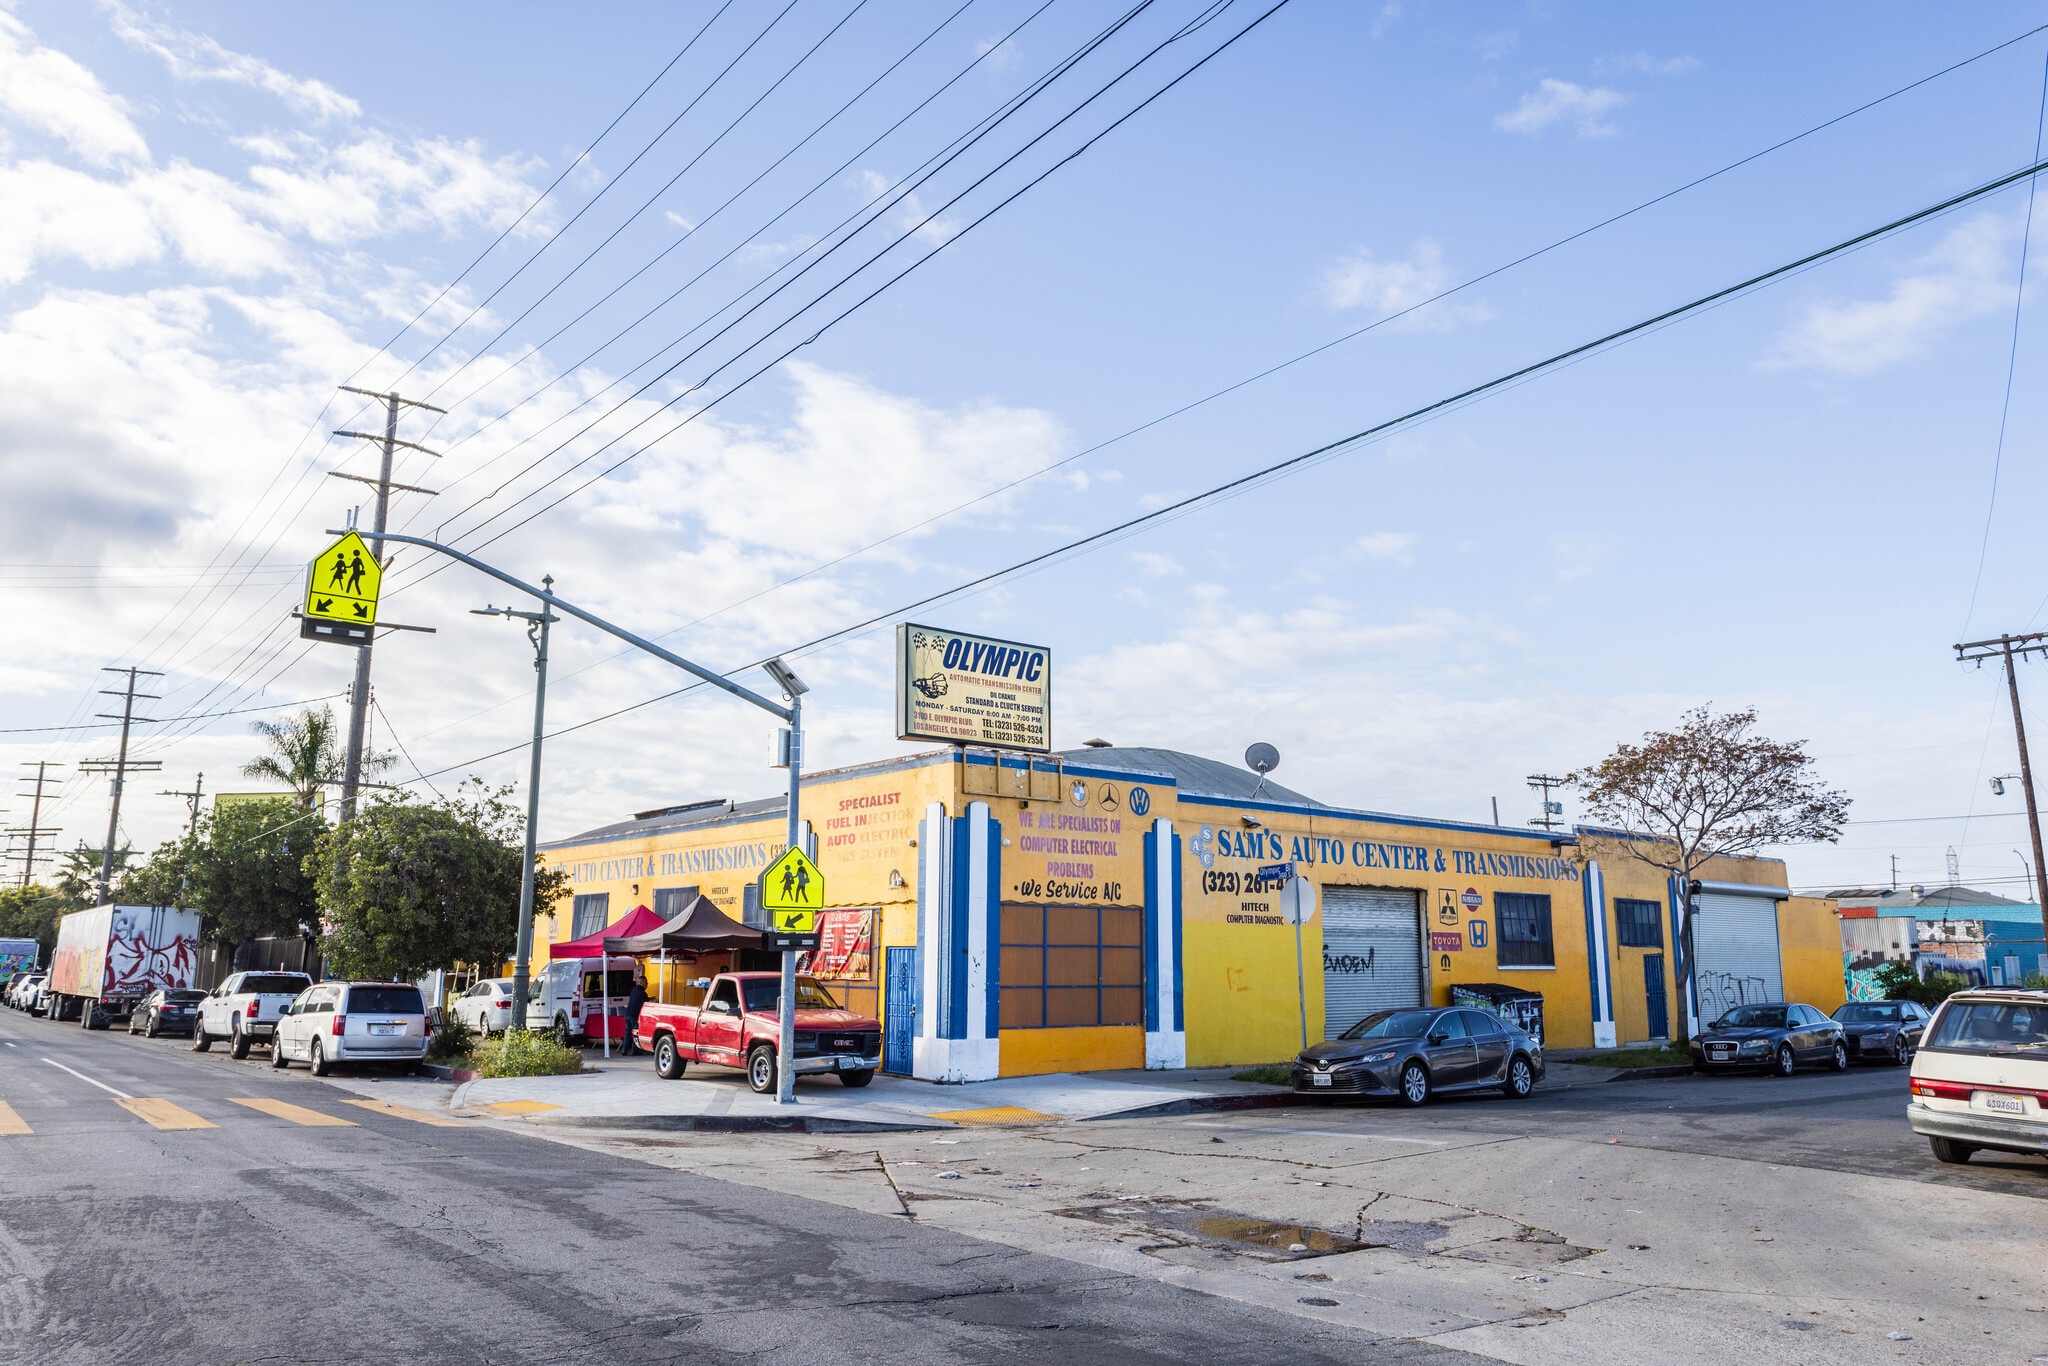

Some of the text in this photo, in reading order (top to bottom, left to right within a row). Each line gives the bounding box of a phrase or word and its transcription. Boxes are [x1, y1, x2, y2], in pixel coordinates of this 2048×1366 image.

[942, 638, 1044, 682] OLYMPIC
[949, 673, 1042, 694] AUTOMATIC TRANSMISSION CENTER
[998, 692, 1016, 701] CHANGE
[915, 700, 944, 710] MONDAY
[949, 705, 984, 716] SATURDAY
[986, 710, 1000, 718] 8:00
[1016, 714, 1030, 722] 7:00
[965, 696, 994, 708] STANDARD
[1000, 701, 1020, 711] CLUCTH
[1021, 704, 1043, 715] SERVICE
[913, 711, 928, 720] 3100
[934, 714, 958, 725] OLYMPIC
[959, 717, 974, 726] BLVD.
[982, 719, 1043, 734] TEL: (323) 526-4324
[913, 722, 977, 737] LOS ANGELES, CA 90023
[982, 730, 1043, 745] TEL: (323) 526-2554
[839, 792, 901, 811] SPECIALIST
[826, 816, 851, 830] FUEL
[1019, 811, 1121, 834] WE ARE SPECIALISTS ON
[827, 833, 856, 847] AUTO
[1020, 835, 1118, 857] COMPUTER ELECTRICAL
[572, 862, 597, 883] AUTO
[600, 857, 644, 881] CENTER
[647, 854, 655, 877] &
[660, 842, 767, 876] TRANSMISSIONS
[1218, 828, 1579, 882] SAM'S AUTO CENTER & TRANSMISSIONS
[1047, 861, 1094, 879] PROBLEMS
[1260, 867, 1280, 876] Olympic
[1021, 879, 1121, 901] We Service A/C
[1202, 870, 1240, 896] (323)
[1241, 902, 1269, 912] HITECH
[1462, 895, 1482, 904] NISSAN
[1226, 915, 1284, 925] COMPUTER DIAGNOSTIC
[1433, 937, 1460, 945] TOYOTA
